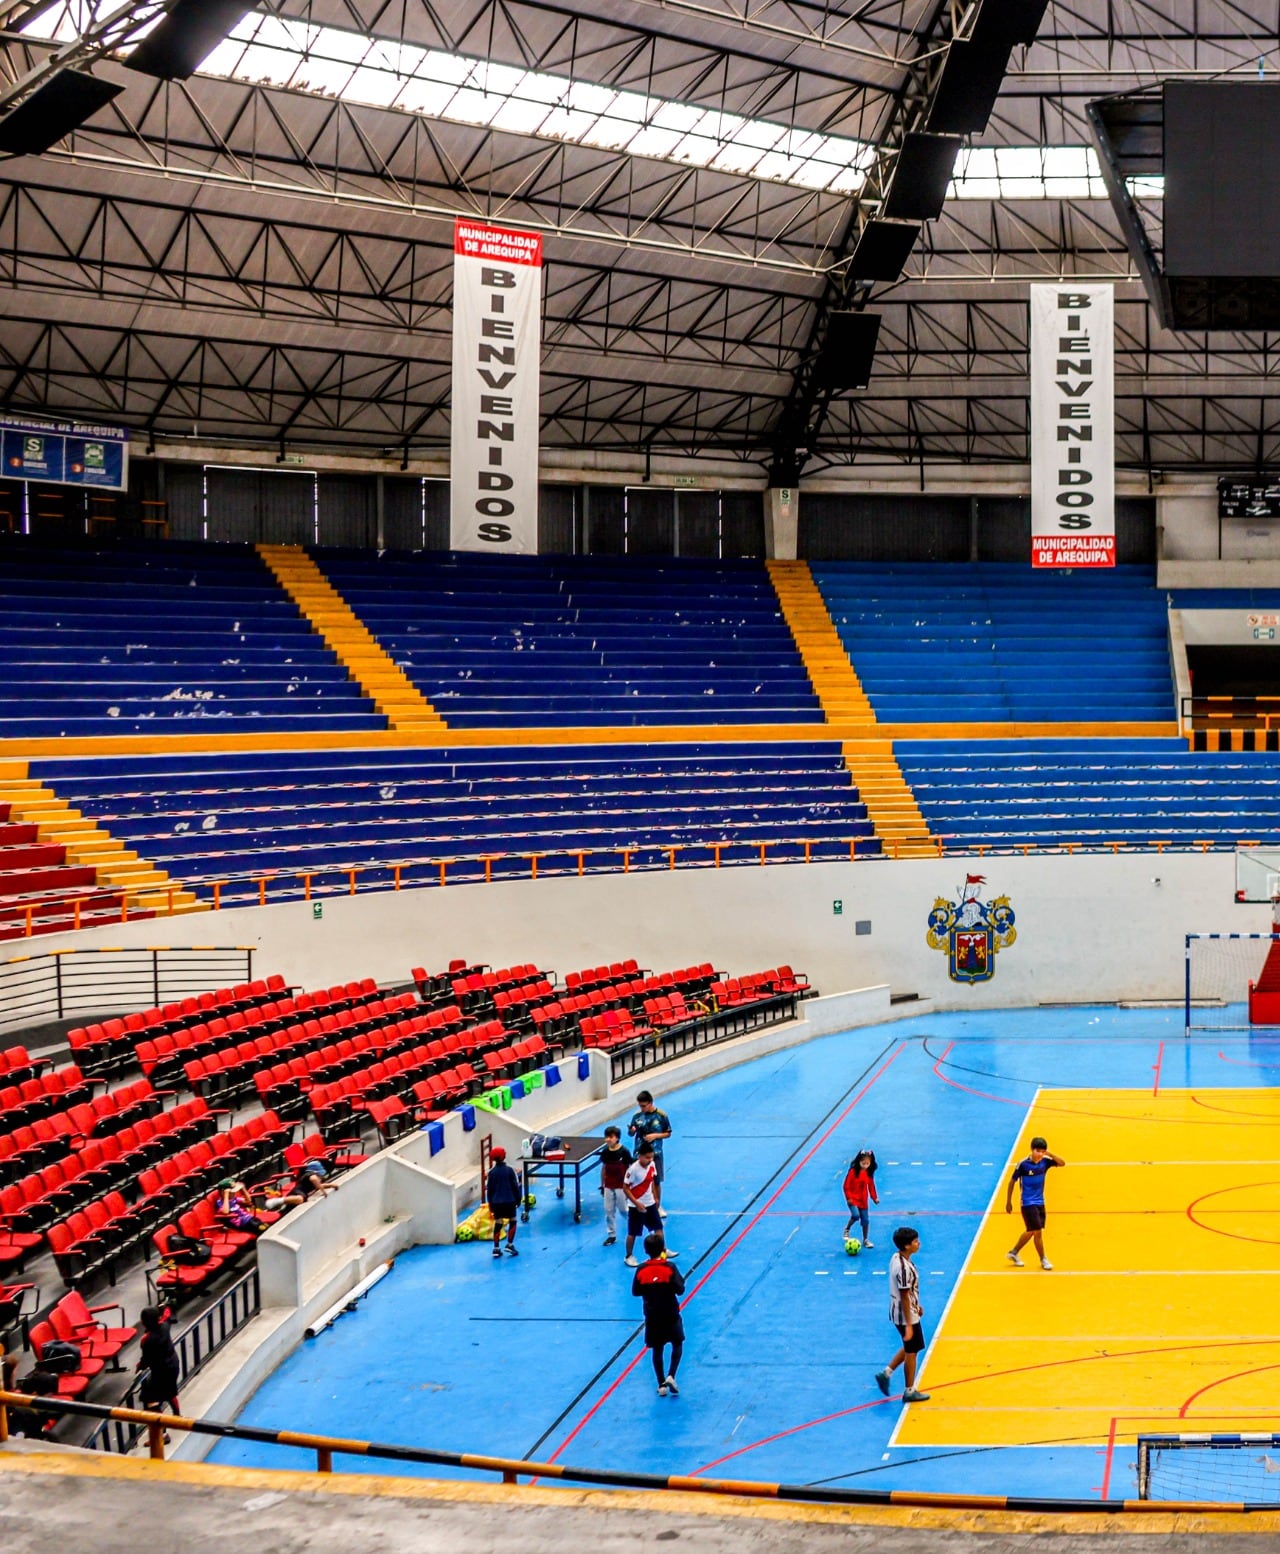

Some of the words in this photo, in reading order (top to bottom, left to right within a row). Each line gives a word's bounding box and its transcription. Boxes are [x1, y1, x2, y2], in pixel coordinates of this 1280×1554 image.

[459, 227, 538, 249] MUNICIPALIDAD
[464, 240, 479, 252] DE
[480, 243, 532, 260] AREQUIPA
[475, 266, 517, 543] BIENVENIDOS
[1055, 292, 1094, 530] BIENVENIDOS
[781, 489, 789, 499] S
[1033, 538, 1114, 549] MUNICIPALIDAD
[1039, 551, 1053, 562] DE
[1055, 550, 1108, 563] AREQUIPA
